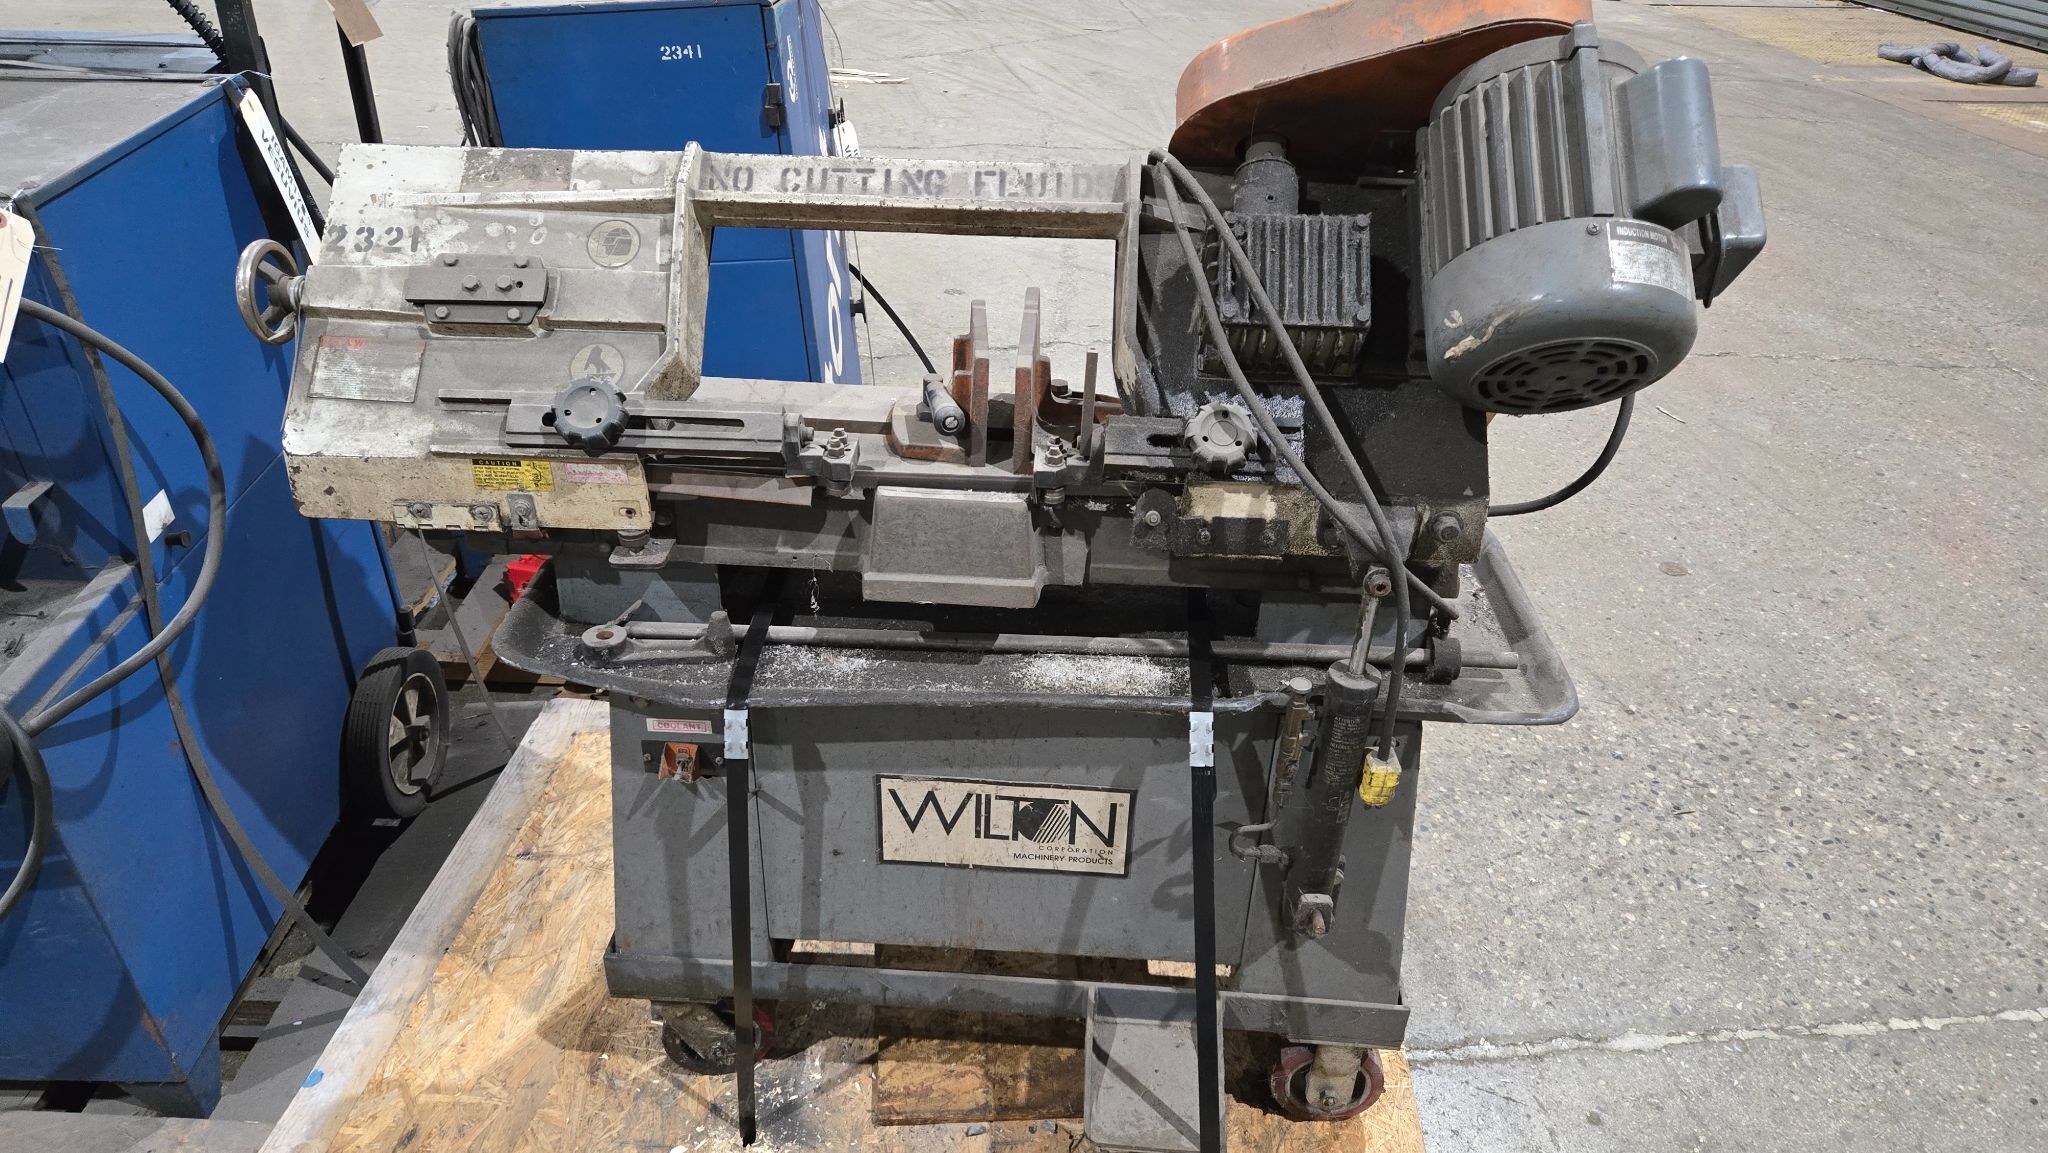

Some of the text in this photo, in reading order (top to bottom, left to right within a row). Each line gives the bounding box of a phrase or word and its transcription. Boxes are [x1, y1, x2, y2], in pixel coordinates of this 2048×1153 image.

[660, 44, 702, 60] 2341
[707, 164, 754, 192] NO
[781, 166, 946, 197] CUTTING
[326, 224, 421, 253] 2321
[657, 721, 702, 730] COOLANT
[887, 788, 1118, 848] WILTON
[1038, 845, 1114, 855] CORPORATION
[1013, 852, 1113, 865] MACHINERY PRODUCTS
